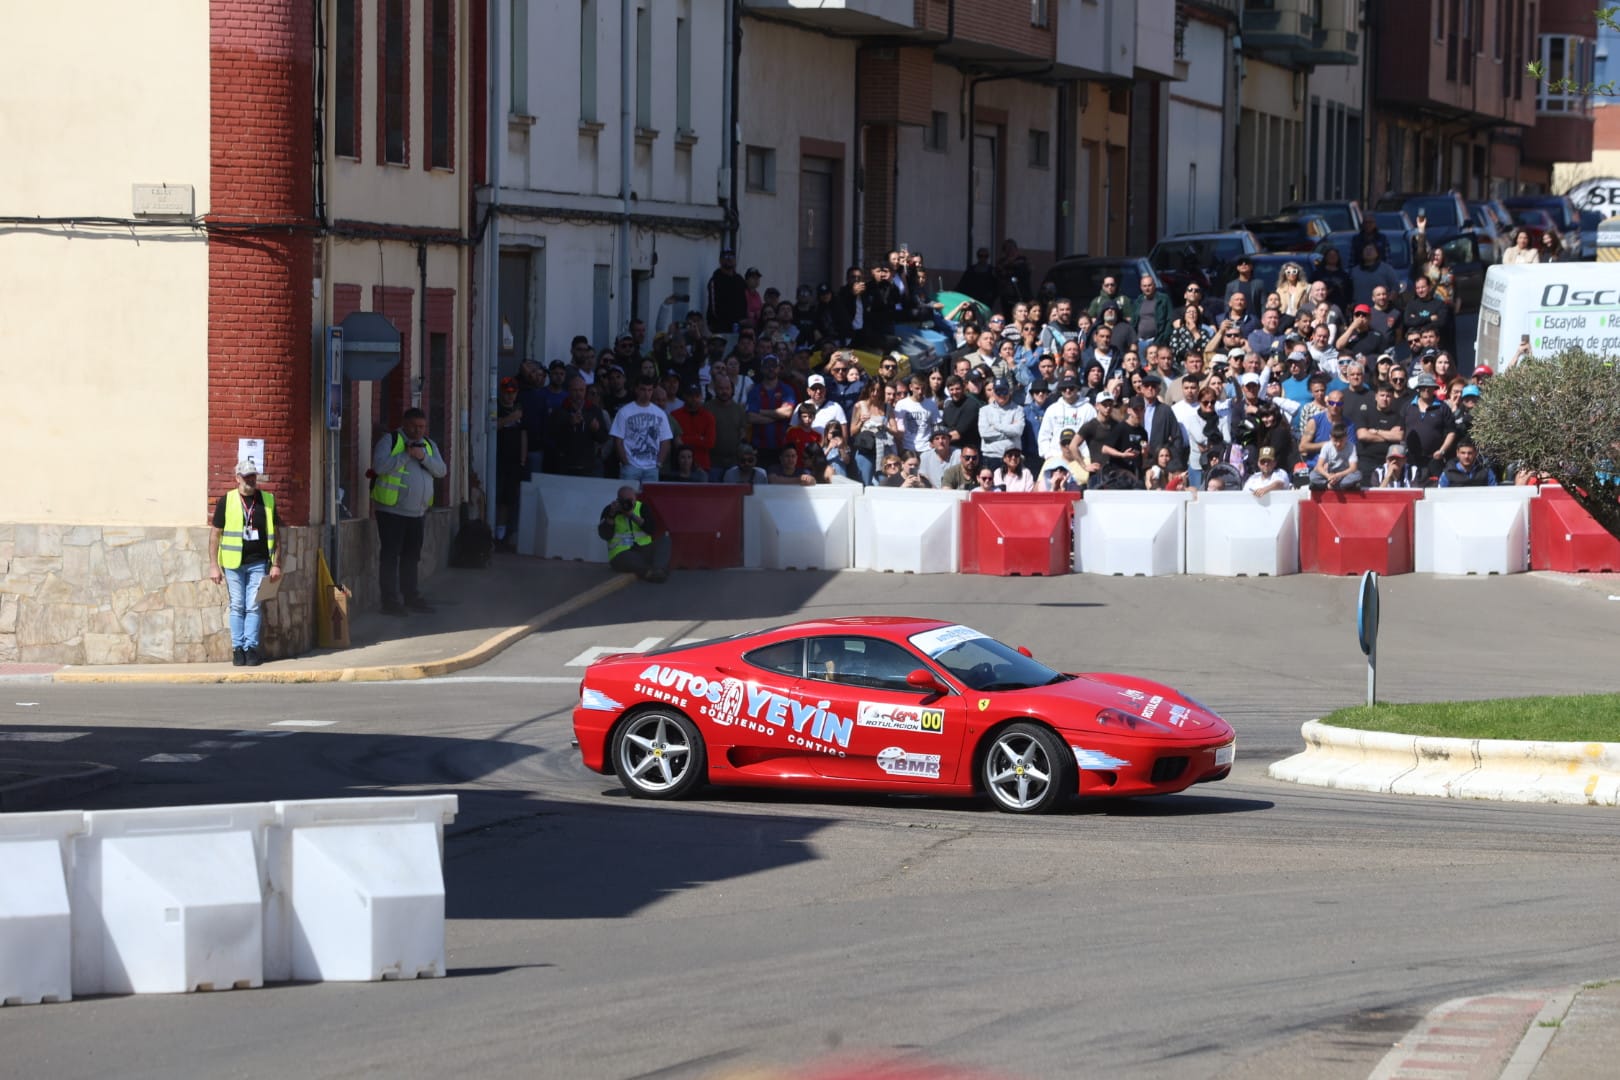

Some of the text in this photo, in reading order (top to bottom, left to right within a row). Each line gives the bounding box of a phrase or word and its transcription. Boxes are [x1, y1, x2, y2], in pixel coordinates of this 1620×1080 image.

[1541, 284, 1620, 307] Osc
[1544, 315, 1586, 331] Escayola
[1586, 336, 1599, 349] de
[639, 664, 854, 748] AUTOS YEYÍN
[633, 683, 846, 758] SIEMPRE SONRIENDO CONTIGO
[922, 711, 941, 730] 00
